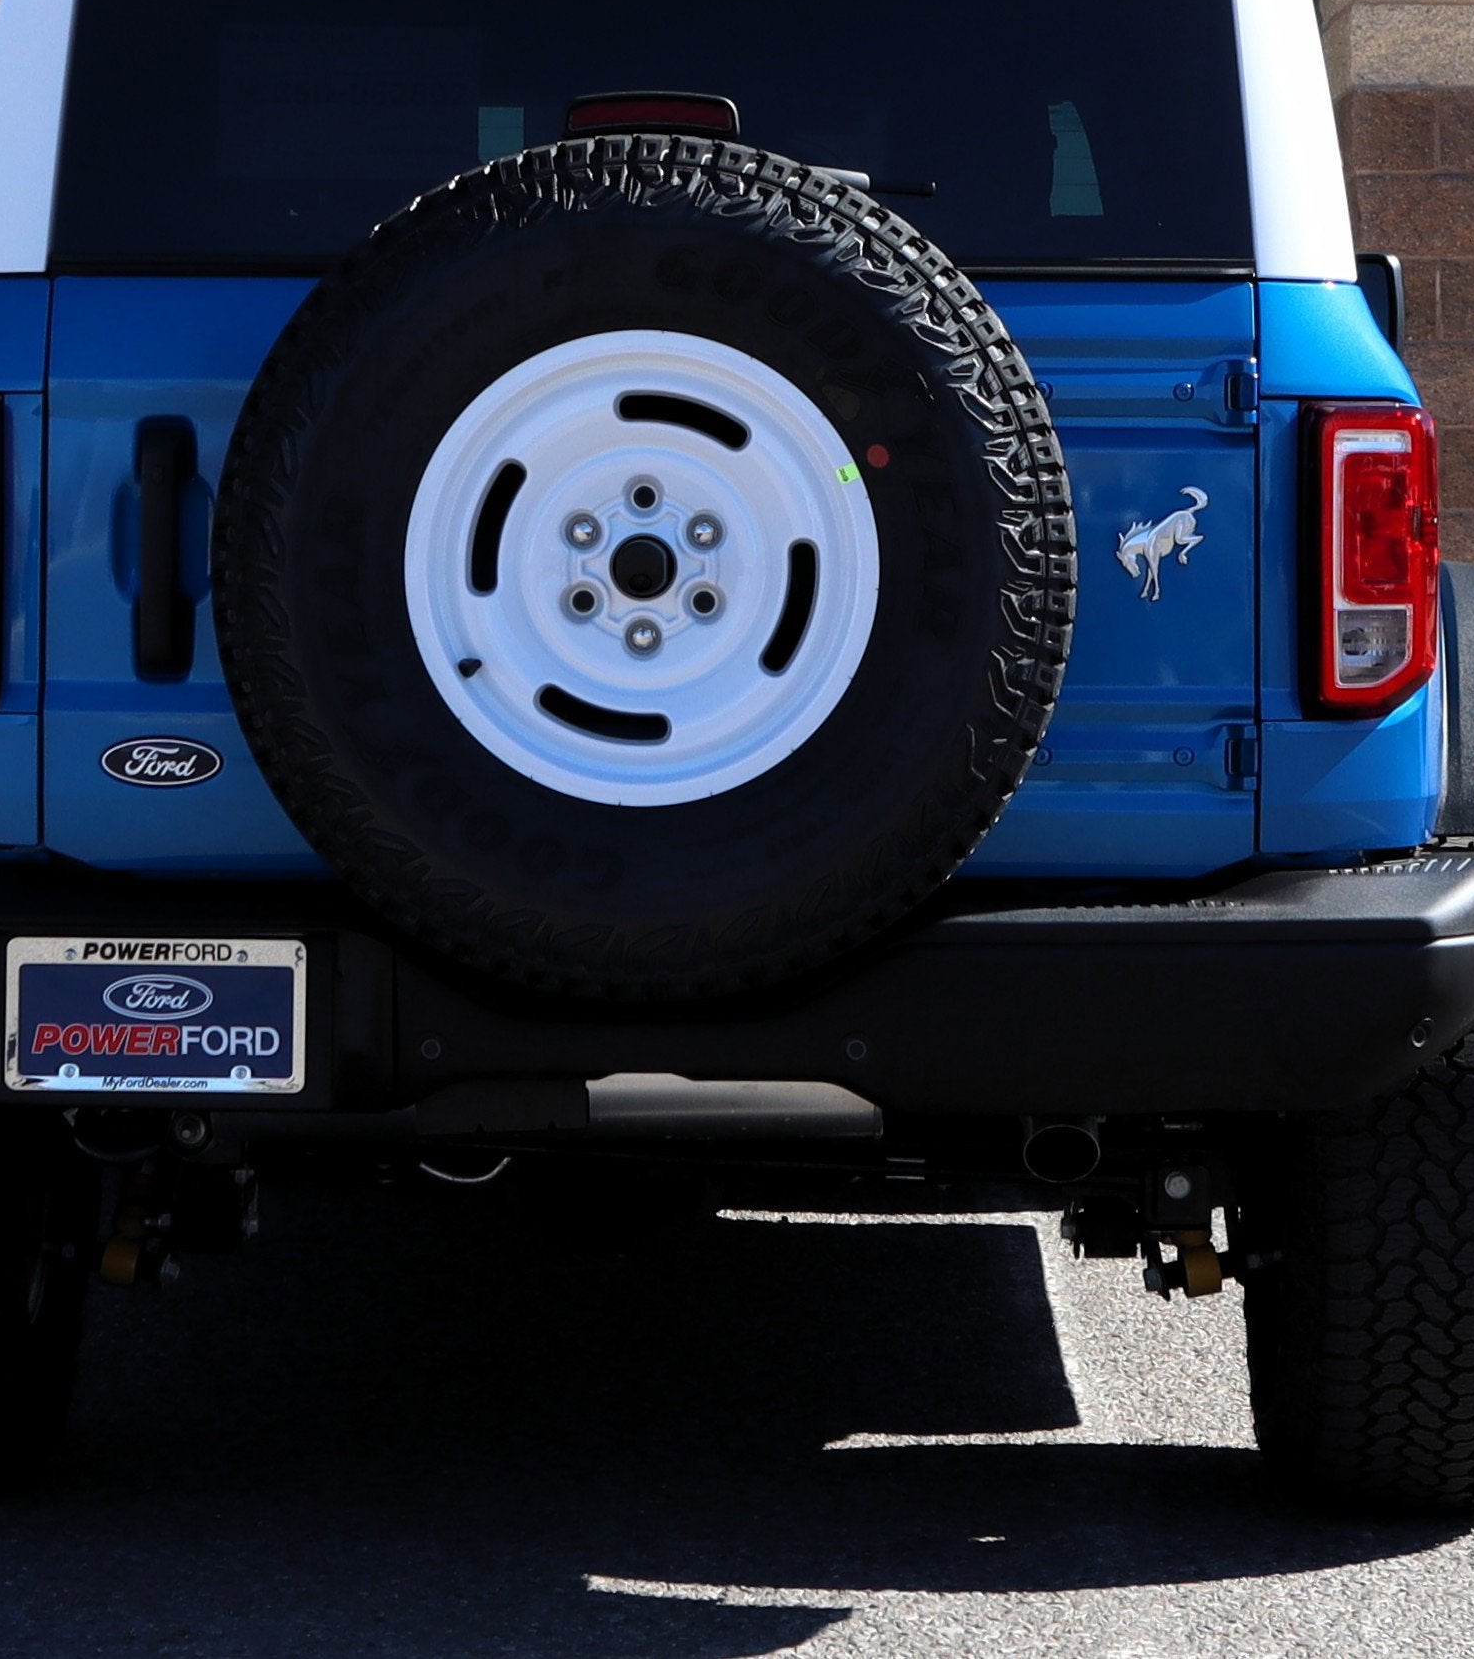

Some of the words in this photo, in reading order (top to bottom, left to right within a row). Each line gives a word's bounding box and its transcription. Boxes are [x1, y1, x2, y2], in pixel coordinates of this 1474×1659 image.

[124, 745, 198, 777] Ford
[82, 942, 232, 961] POWERFORD
[125, 982, 189, 1010] Ford
[31, 1023, 281, 1057] POWERFORD
[102, 1076, 208, 1090] MyFordDealer.com
